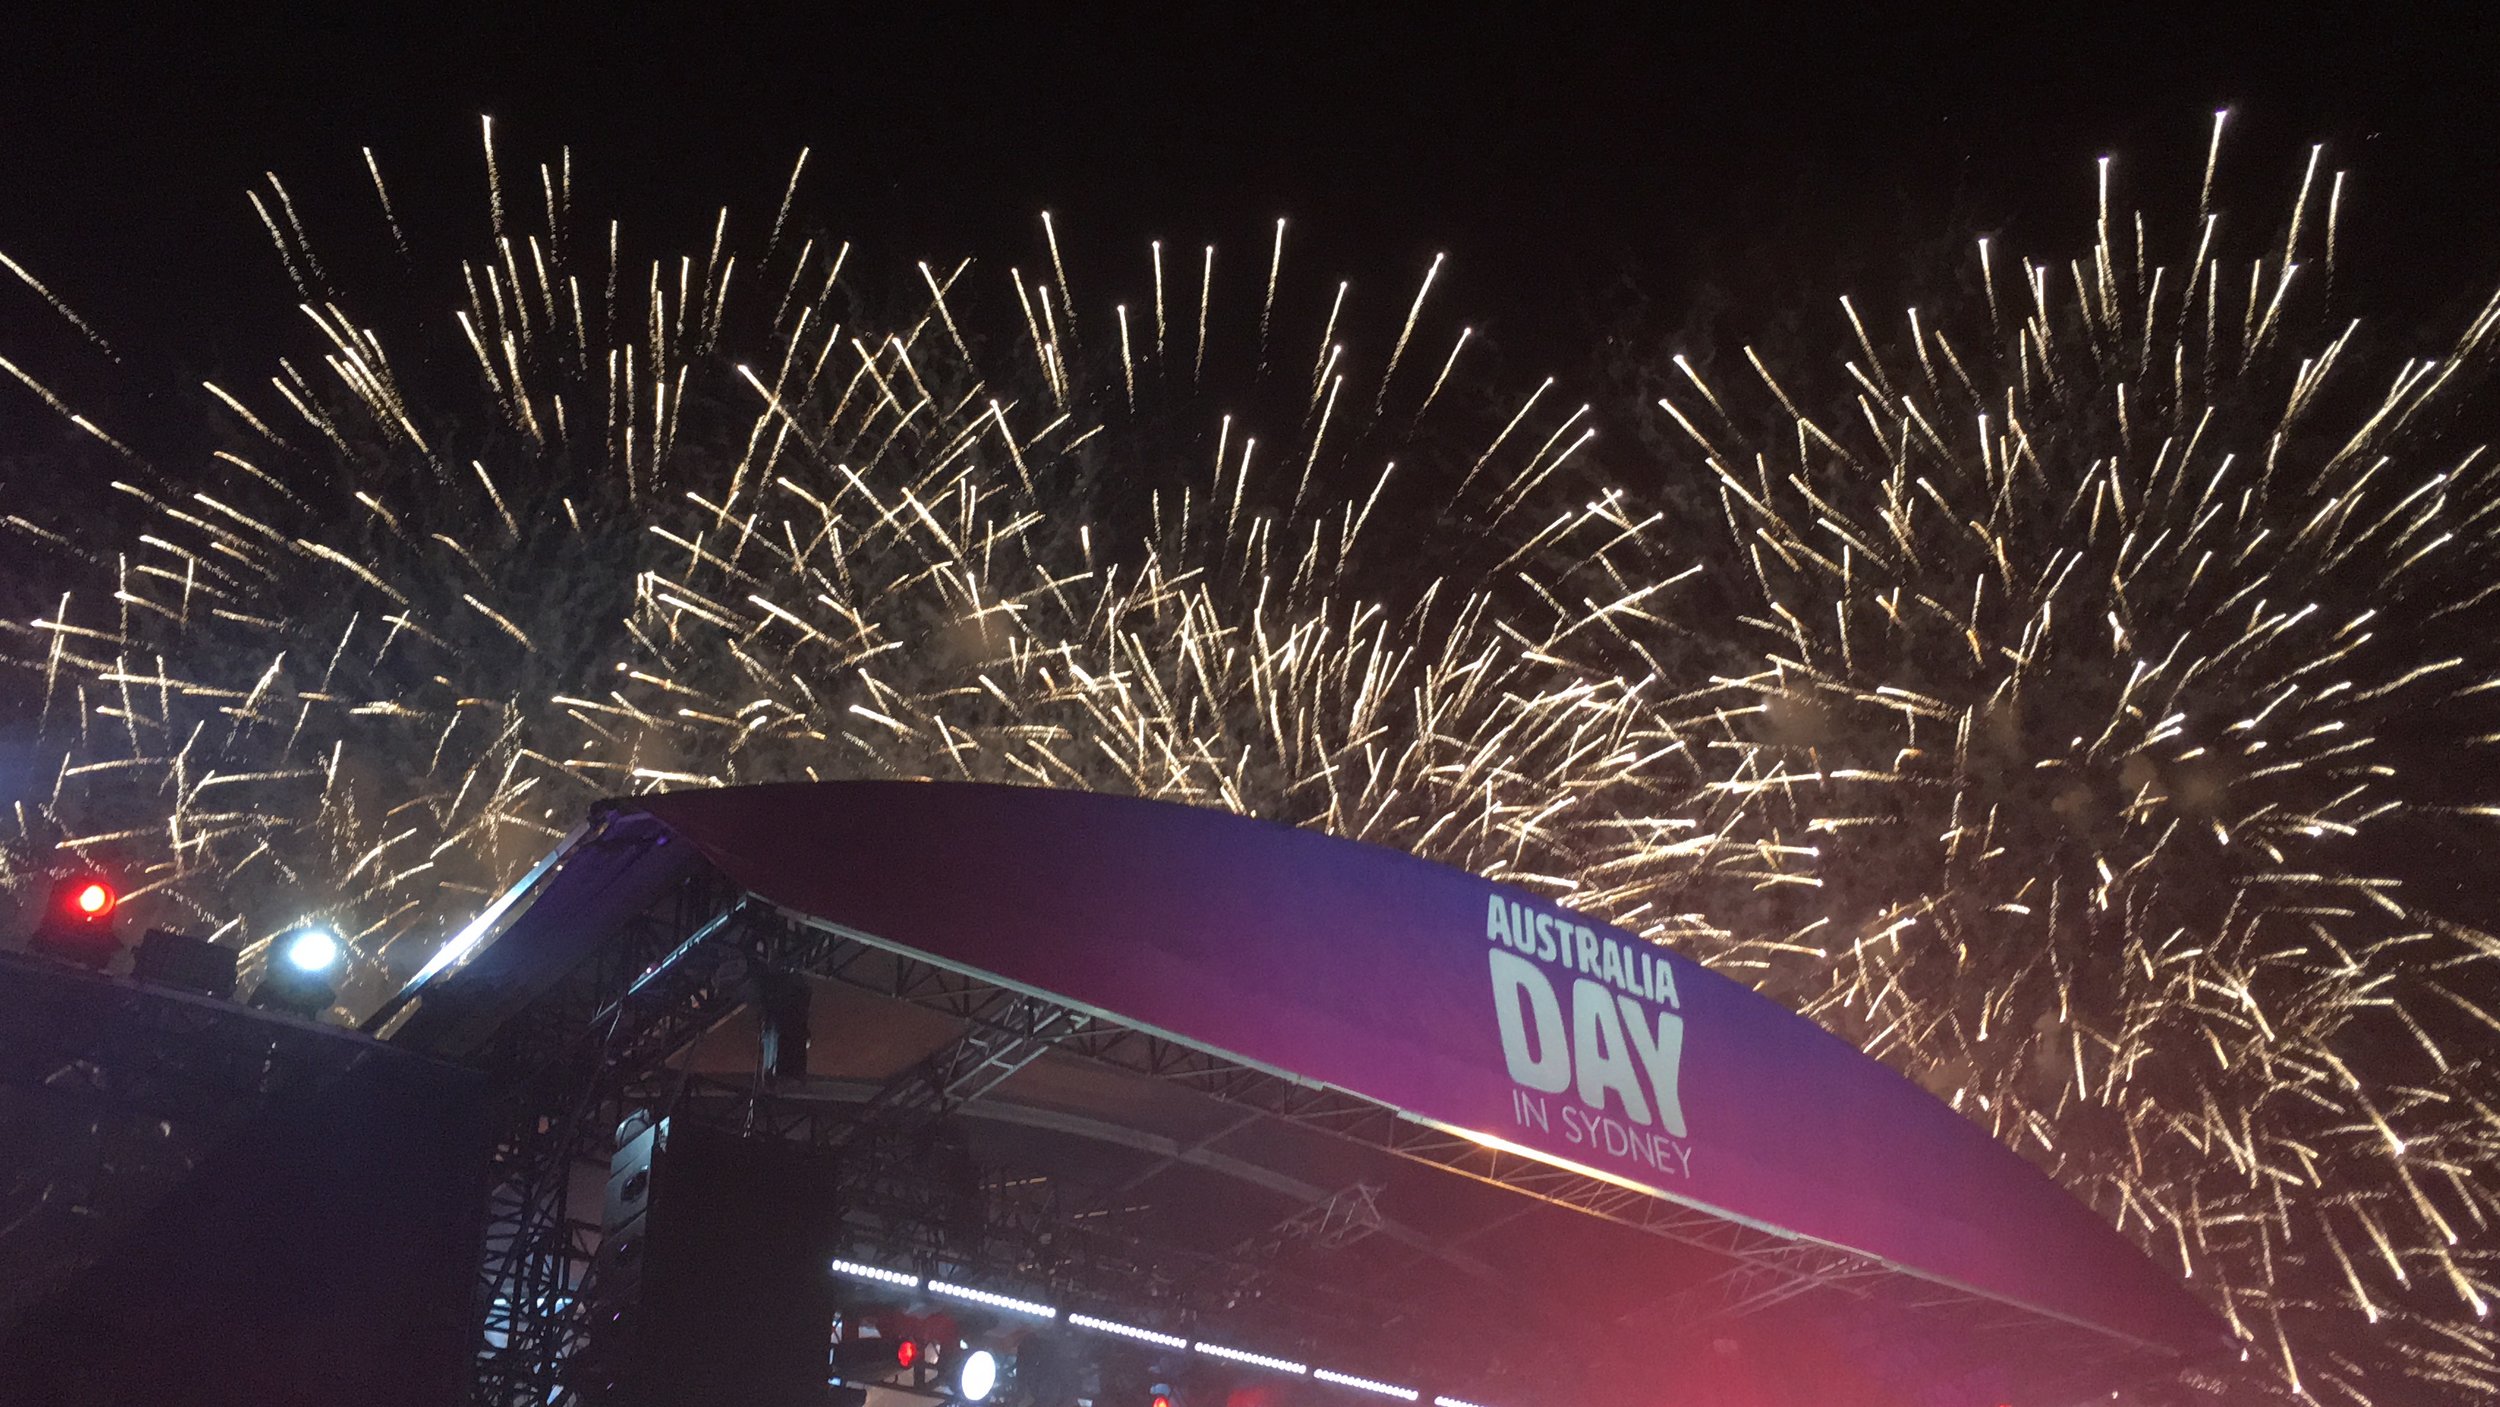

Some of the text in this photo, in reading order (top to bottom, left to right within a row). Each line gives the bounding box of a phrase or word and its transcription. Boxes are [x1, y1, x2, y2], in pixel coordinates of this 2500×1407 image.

[1487, 894, 1680, 1008] AUSTRALIA
[1489, 948, 1687, 1138] DAY
[1512, 1089, 1691, 1179] IN SYDNEY
